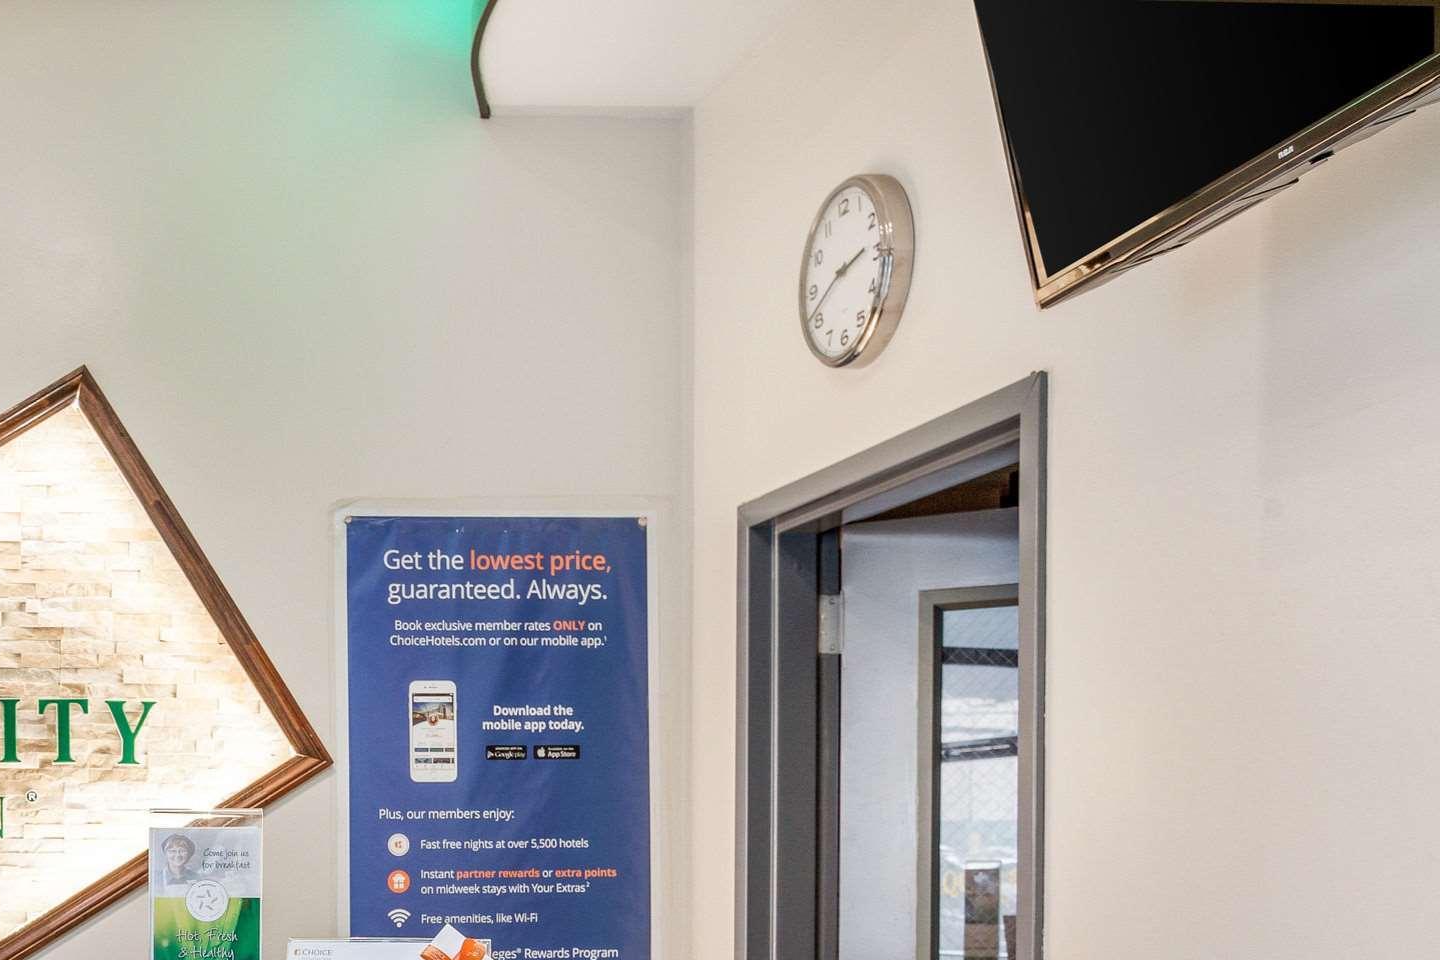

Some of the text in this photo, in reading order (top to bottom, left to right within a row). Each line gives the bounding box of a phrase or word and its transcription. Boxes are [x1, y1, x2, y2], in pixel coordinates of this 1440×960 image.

[838, 198, 850, 218] 12
[867, 212, 877, 231] 2
[824, 220, 833, 239] 11
[814, 249, 824, 267] 10
[808, 284, 818, 300] 9
[814, 312, 824, 329] 8
[856, 309, 866, 328] 5
[825, 329, 834, 347] 7
[840, 328, 850, 347] 6
[382, 548, 612, 577] Get the lowest price,
[387, 577, 608, 606] guaranteed. Always.
[394, 619, 603, 632] Book exclusive member rates ONLY on
[389, 634, 487, 647] ChoiceHotels.com
[488, 636, 502, 647] or
[503, 636, 518, 647] on
[519, 636, 540, 647] our
[540, 635, 579, 647] mobile
[492, 704, 574, 717] Download the
[482, 718, 585, 733] mobile app today.
[547, 751, 577, 760] App Store
[378, 807, 515, 821] Plus, our members enjoy:
[420, 837, 590, 852] Fast free nights at over 5,500 hotels
[203, 848, 225, 857] Come
[420, 867, 618, 881] Instant partner rewards or extra points
[420, 885, 434, 895] on
[435, 884, 481, 895] midweek
[481, 884, 507, 896] stays
[509, 883, 530, 893] with
[531, 883, 555, 893] Your
[421, 912, 538, 925] Free amenities, like Wi-Fi
[207, 927, 238, 943] Fresh
[177, 946, 188, 958] &
[524, 947, 570, 960] Rewards
[572, 947, 619, 960] Program
